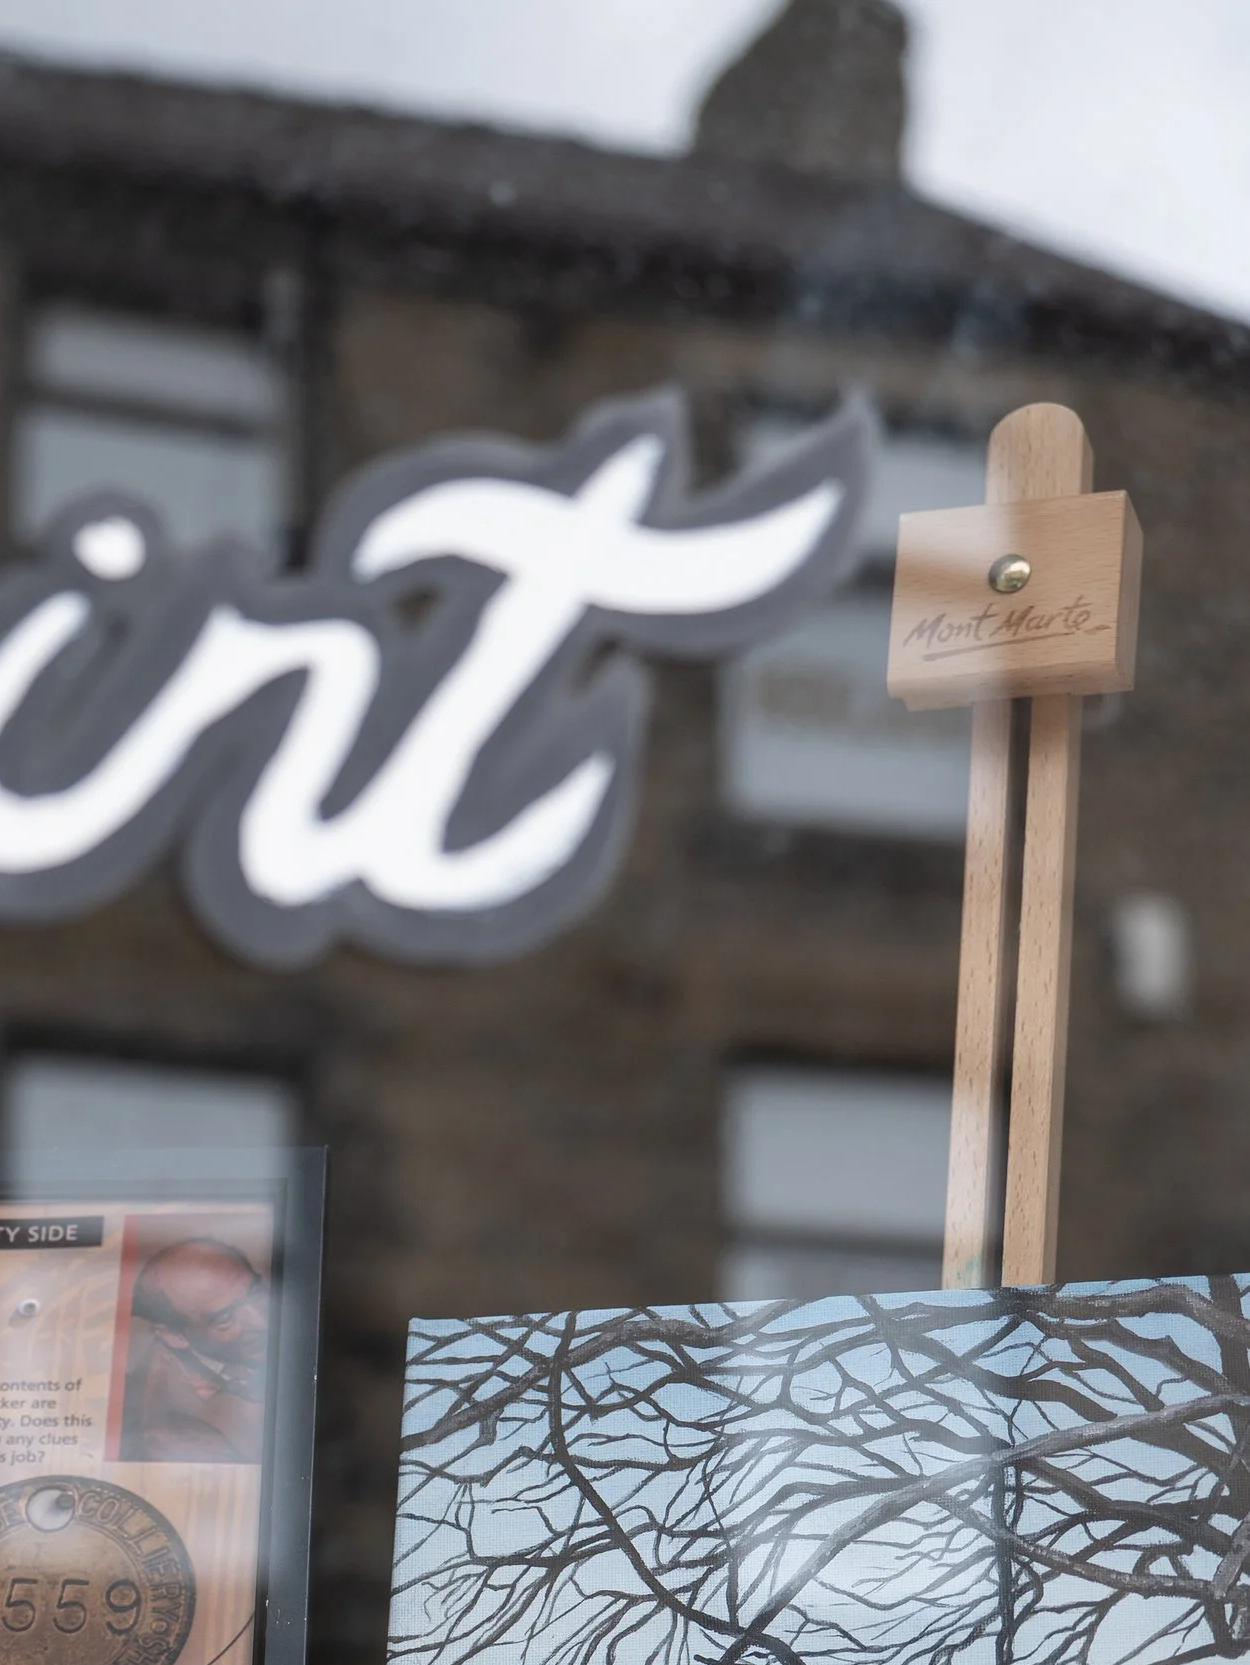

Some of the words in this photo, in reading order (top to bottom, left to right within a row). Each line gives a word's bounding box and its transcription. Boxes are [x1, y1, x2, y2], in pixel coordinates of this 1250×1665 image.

[902, 602, 998, 648] Mont
[988, 594, 1095, 637] Marte
[27, 1224, 79, 1243] SIDE
[64, 1378, 83, 1391] of
[30, 1399, 57, 1410] are
[20, 1414, 59, 1427] Does
[64, 1413, 93, 1427] this
[6, 1435, 35, 1448] any
[38, 1432, 78, 1445] clues
[9, 1450, 46, 1466] job?
[74, 1490, 184, 1624] COLLIERY
